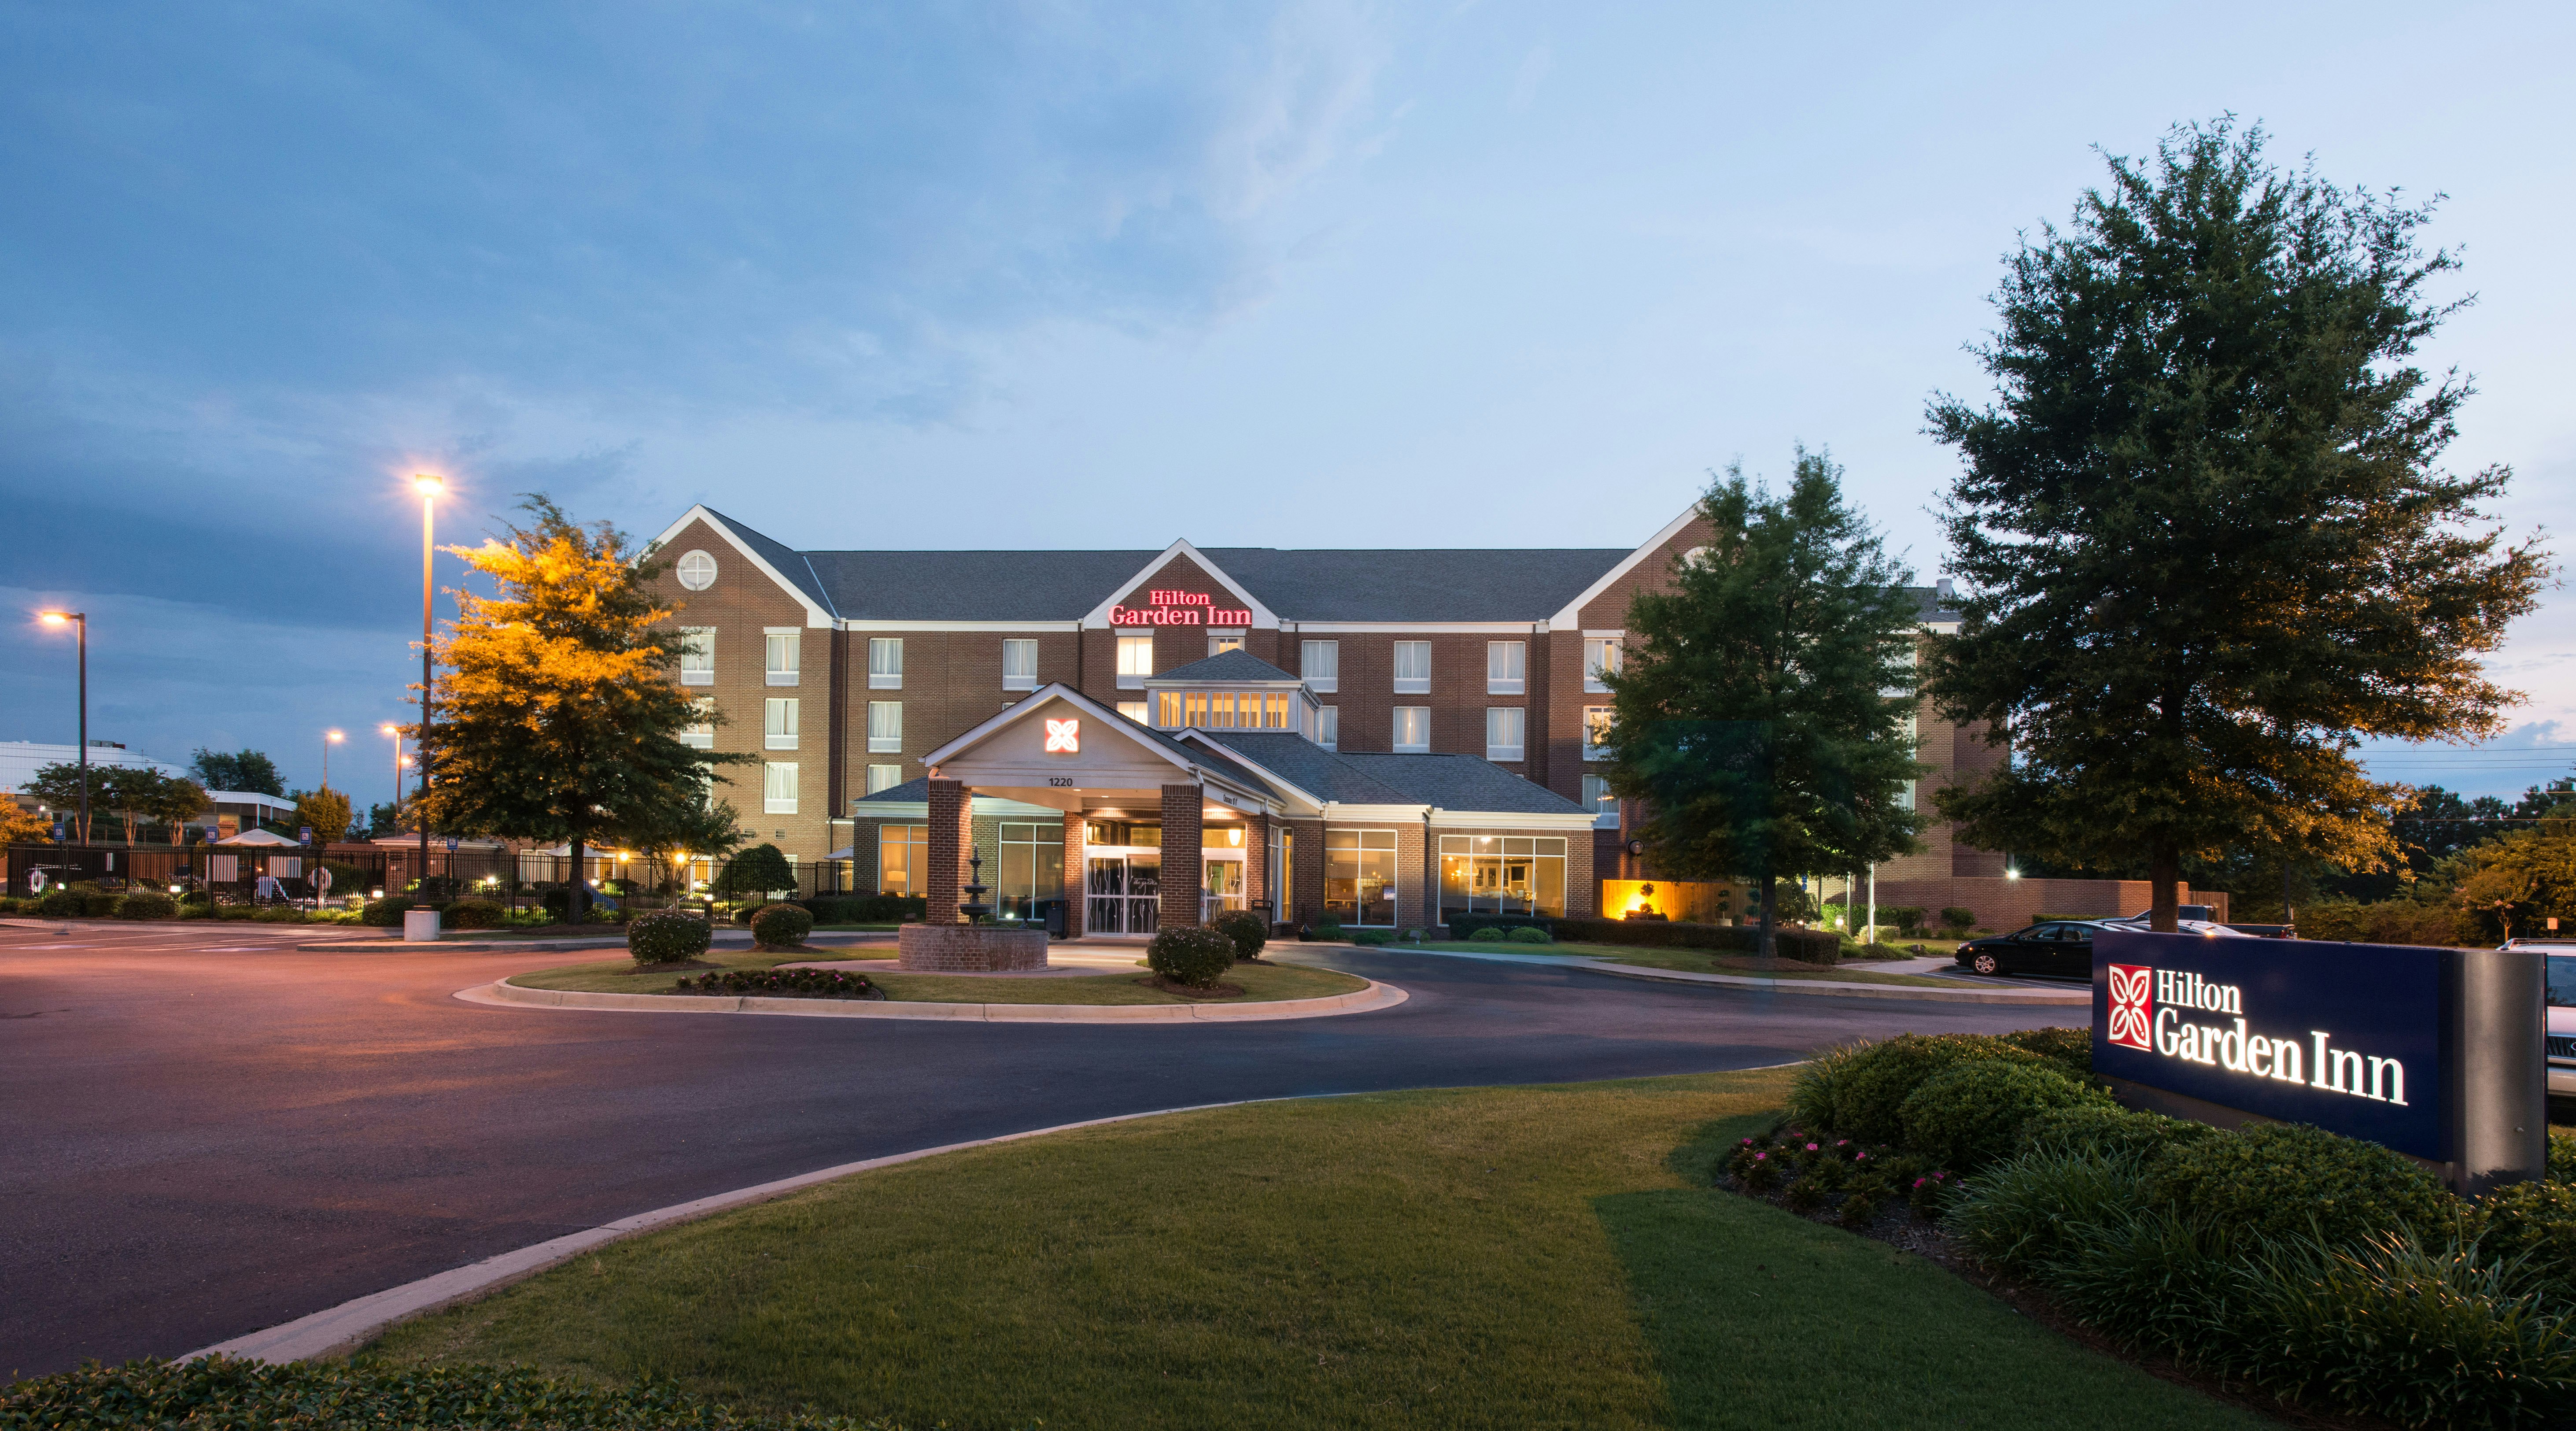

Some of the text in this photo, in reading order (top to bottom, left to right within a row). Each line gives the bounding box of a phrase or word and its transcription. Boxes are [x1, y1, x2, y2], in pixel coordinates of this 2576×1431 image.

[1150, 590, 1210, 605] Hilton
[1108, 605, 1252, 625] Garden Inn
[1049, 777, 1073, 787] 1220
[2156, 969, 2242, 1014] Hilton
[2155, 1007, 2409, 1106] Garden Inn
